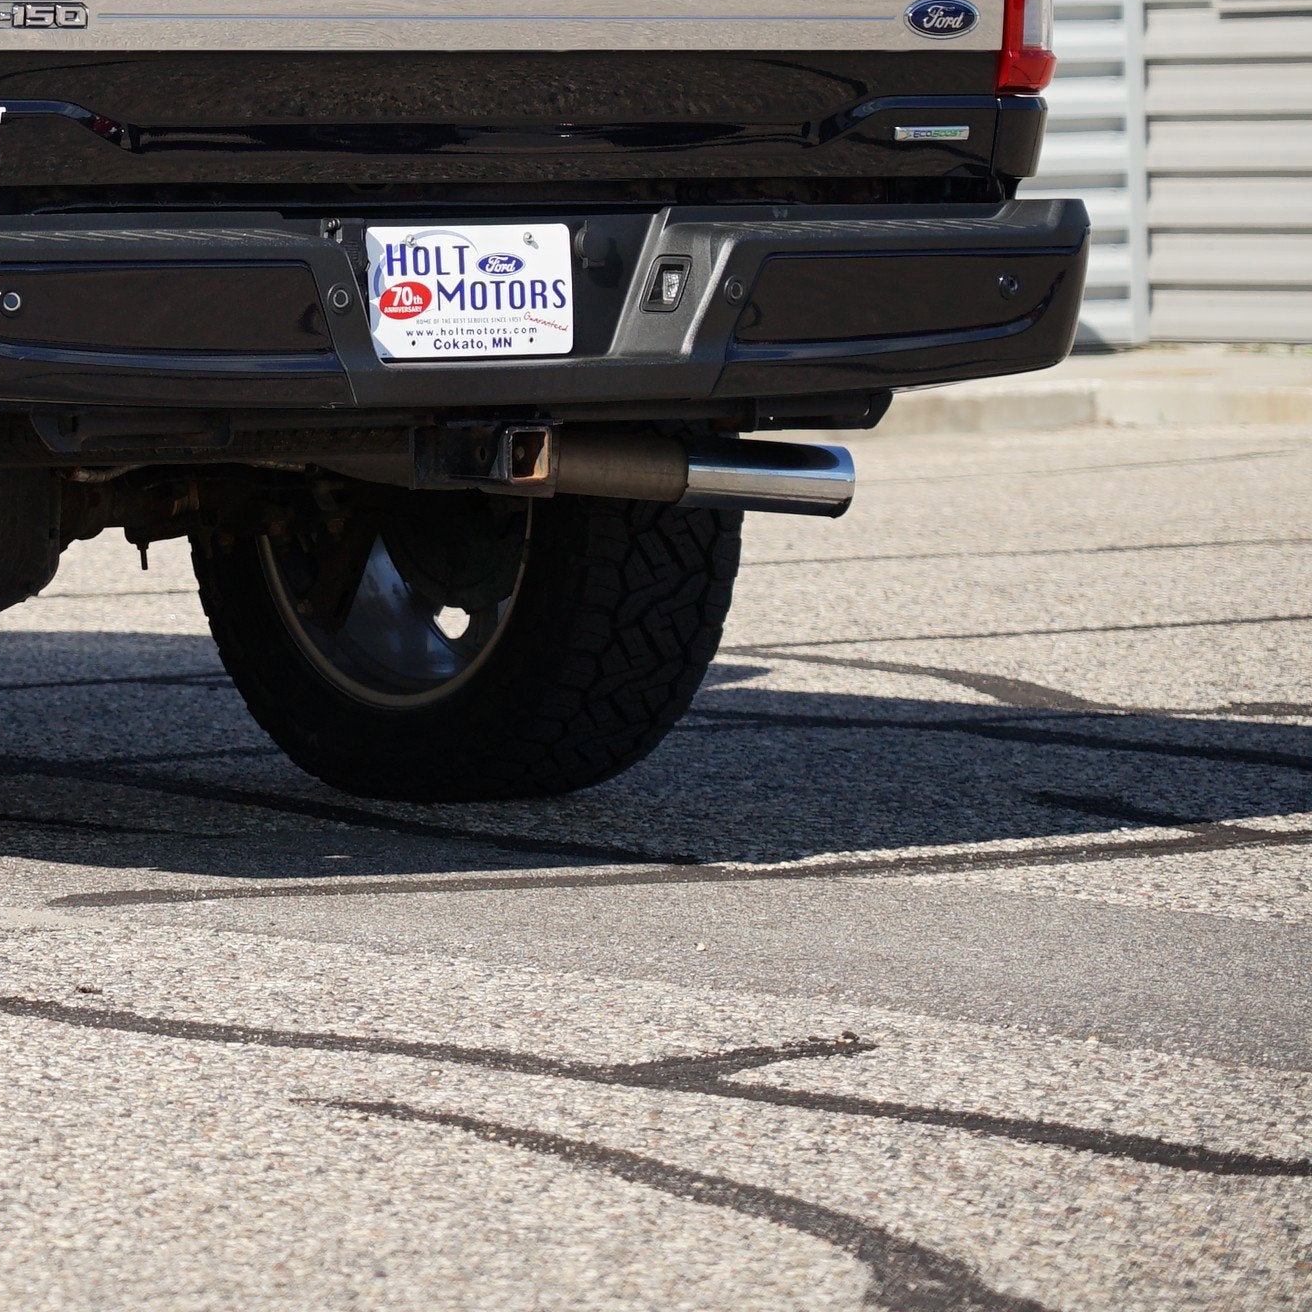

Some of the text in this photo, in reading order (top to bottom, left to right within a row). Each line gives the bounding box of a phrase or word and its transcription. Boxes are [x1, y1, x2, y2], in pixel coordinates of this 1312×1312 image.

[922, 4, 966, 30] Ford
[386, 243, 470, 277] HOLT
[484, 256, 517, 273] Ford
[390, 286, 424, 306] 70th
[436, 278, 567, 311] MOTORS
[383, 305, 423, 314] ANNIVERSARY
[406, 326, 538, 337] www.holtmotors.com
[523, 311, 569, 332] Guaranteed
[433, 337, 512, 351] Cokato, MN
